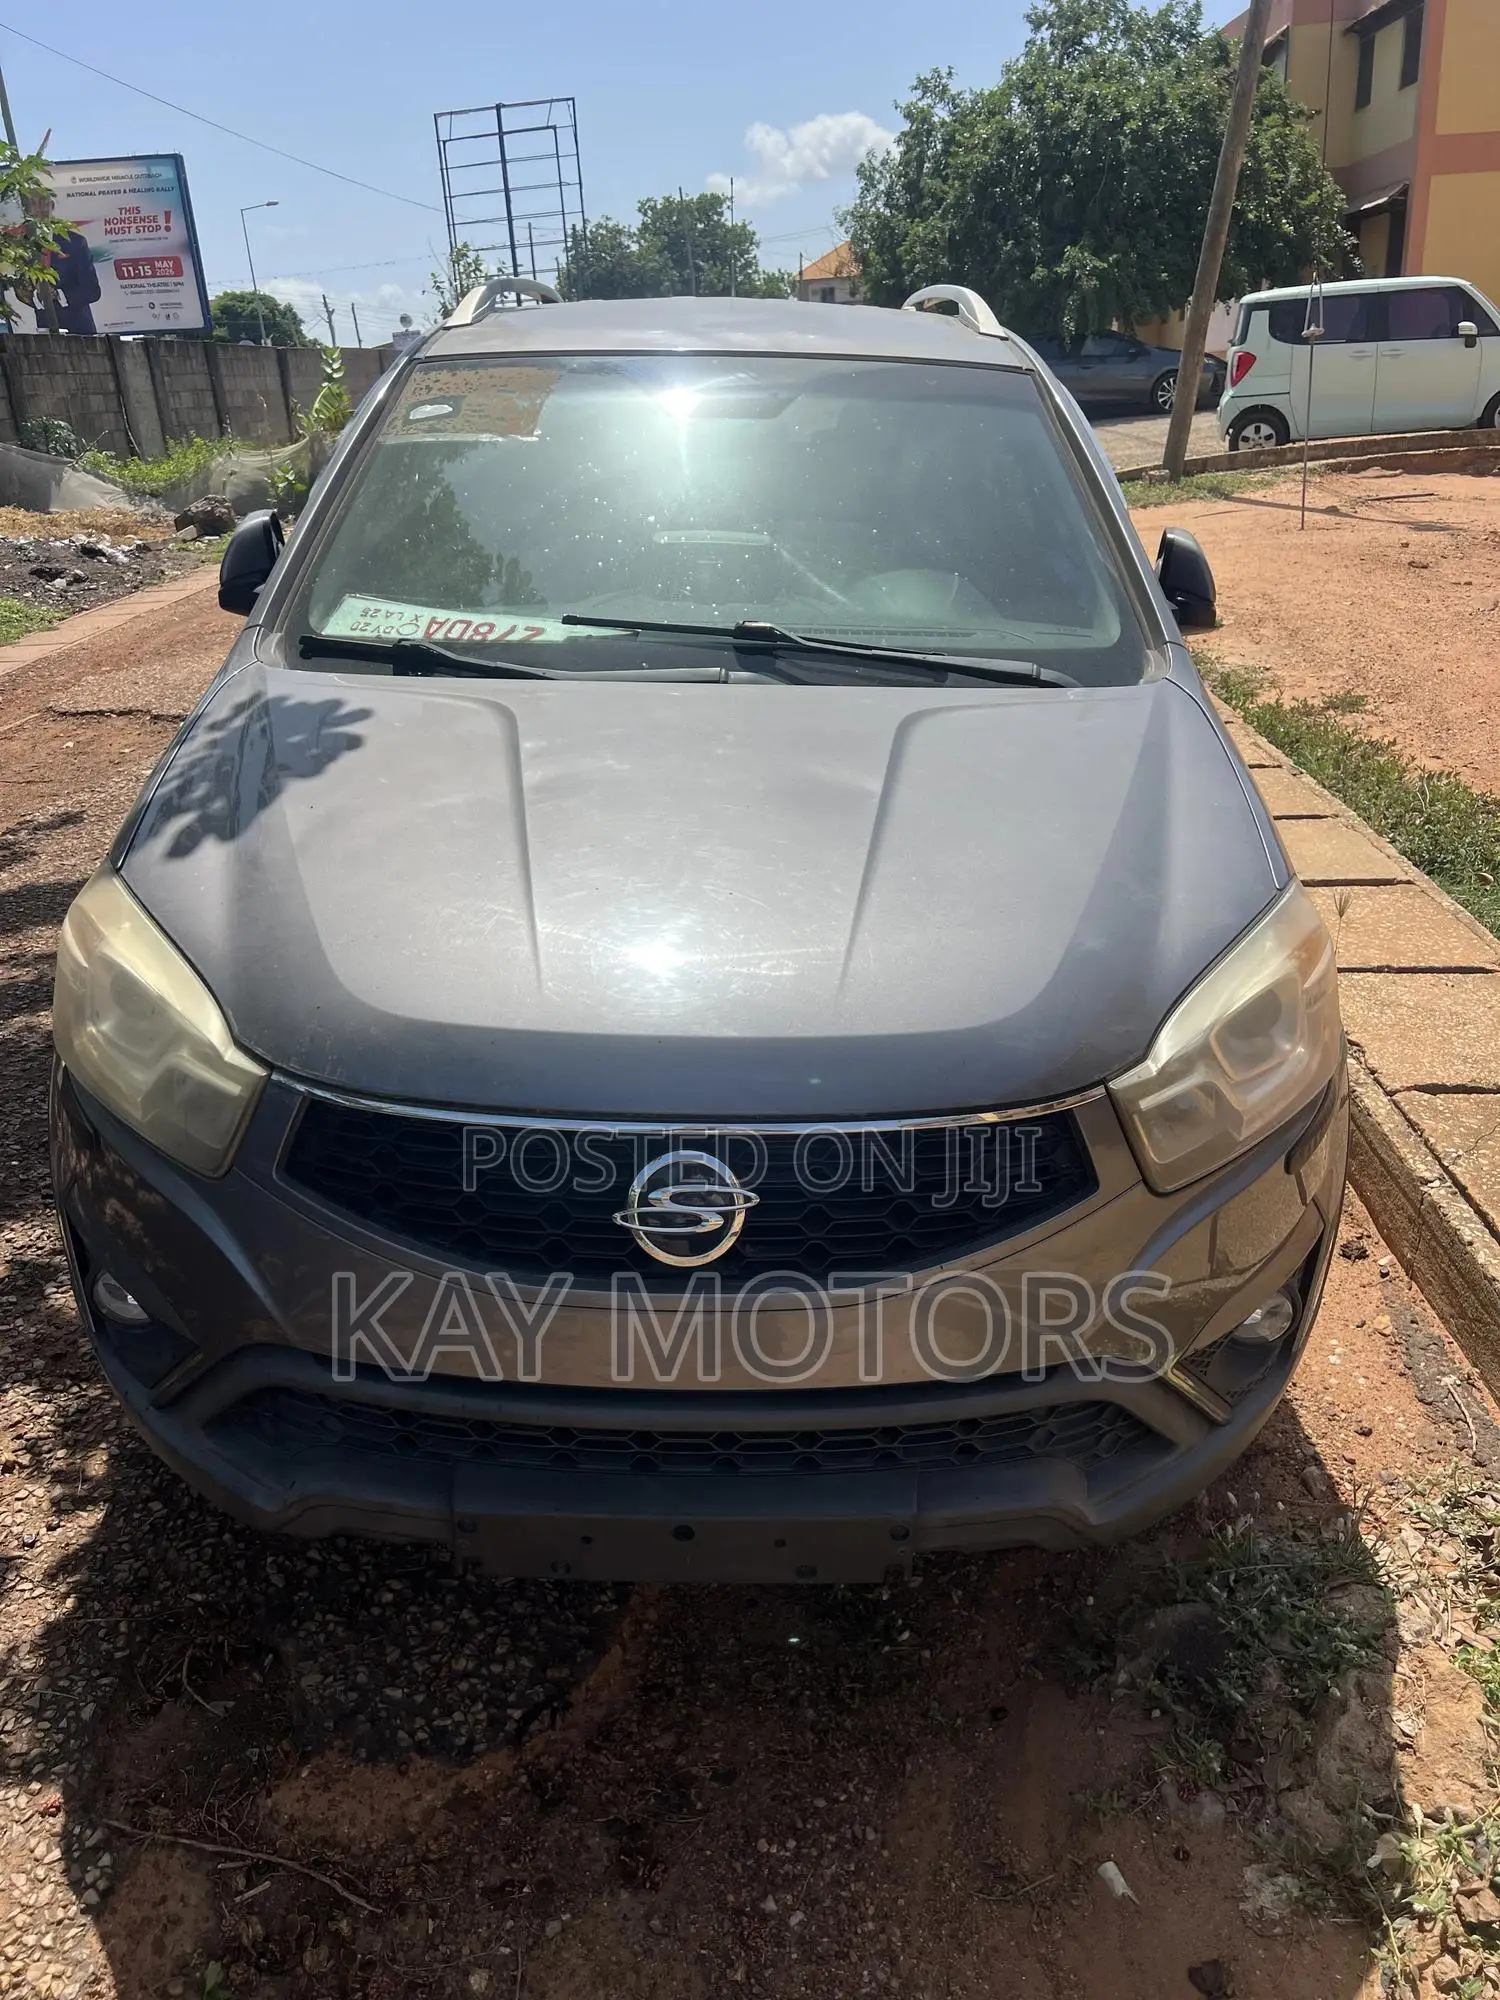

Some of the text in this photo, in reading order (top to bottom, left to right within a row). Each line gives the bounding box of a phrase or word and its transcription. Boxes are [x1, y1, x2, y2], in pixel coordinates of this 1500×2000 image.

[129, 186, 155, 194] HEALING
[118, 206, 141, 216] THIS
[104, 215, 159, 227] NONSENSE
[104, 226, 132, 236] MUST
[135, 224, 162, 234] STOP
[154, 260, 174, 269] MAY
[121, 265, 152, 278] 11-15
